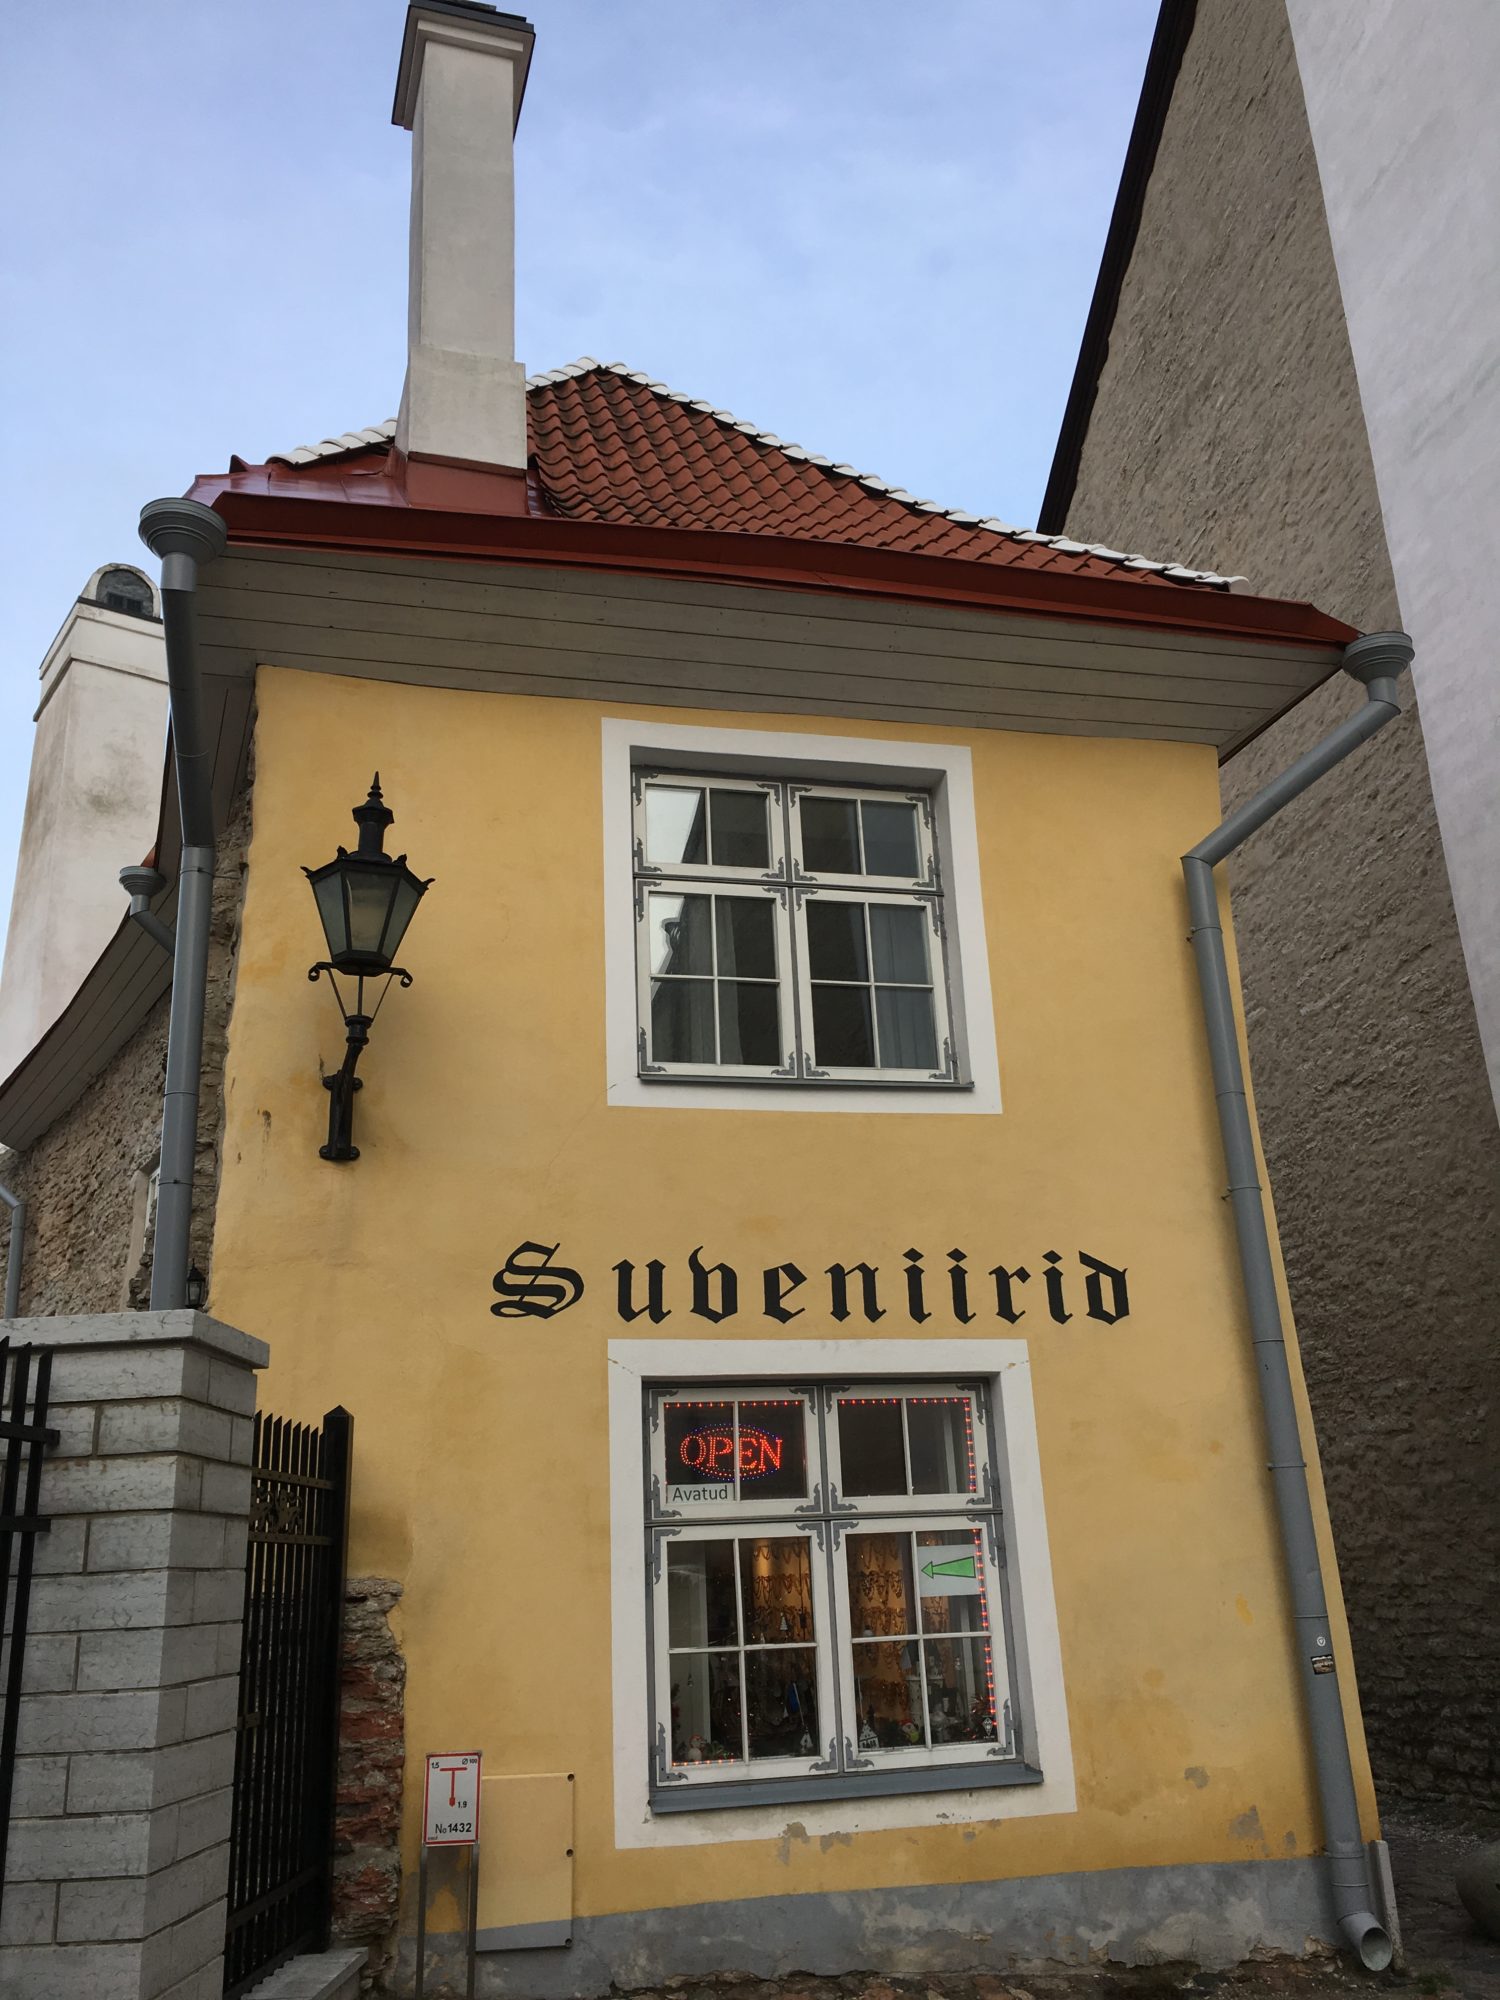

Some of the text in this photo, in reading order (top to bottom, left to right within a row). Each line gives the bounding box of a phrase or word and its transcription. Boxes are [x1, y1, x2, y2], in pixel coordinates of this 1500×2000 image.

[490, 1241, 1131, 1325] Suveniirid
[680, 1435, 783, 1472] OPEN
[672, 1485, 728, 1502] Avatud
